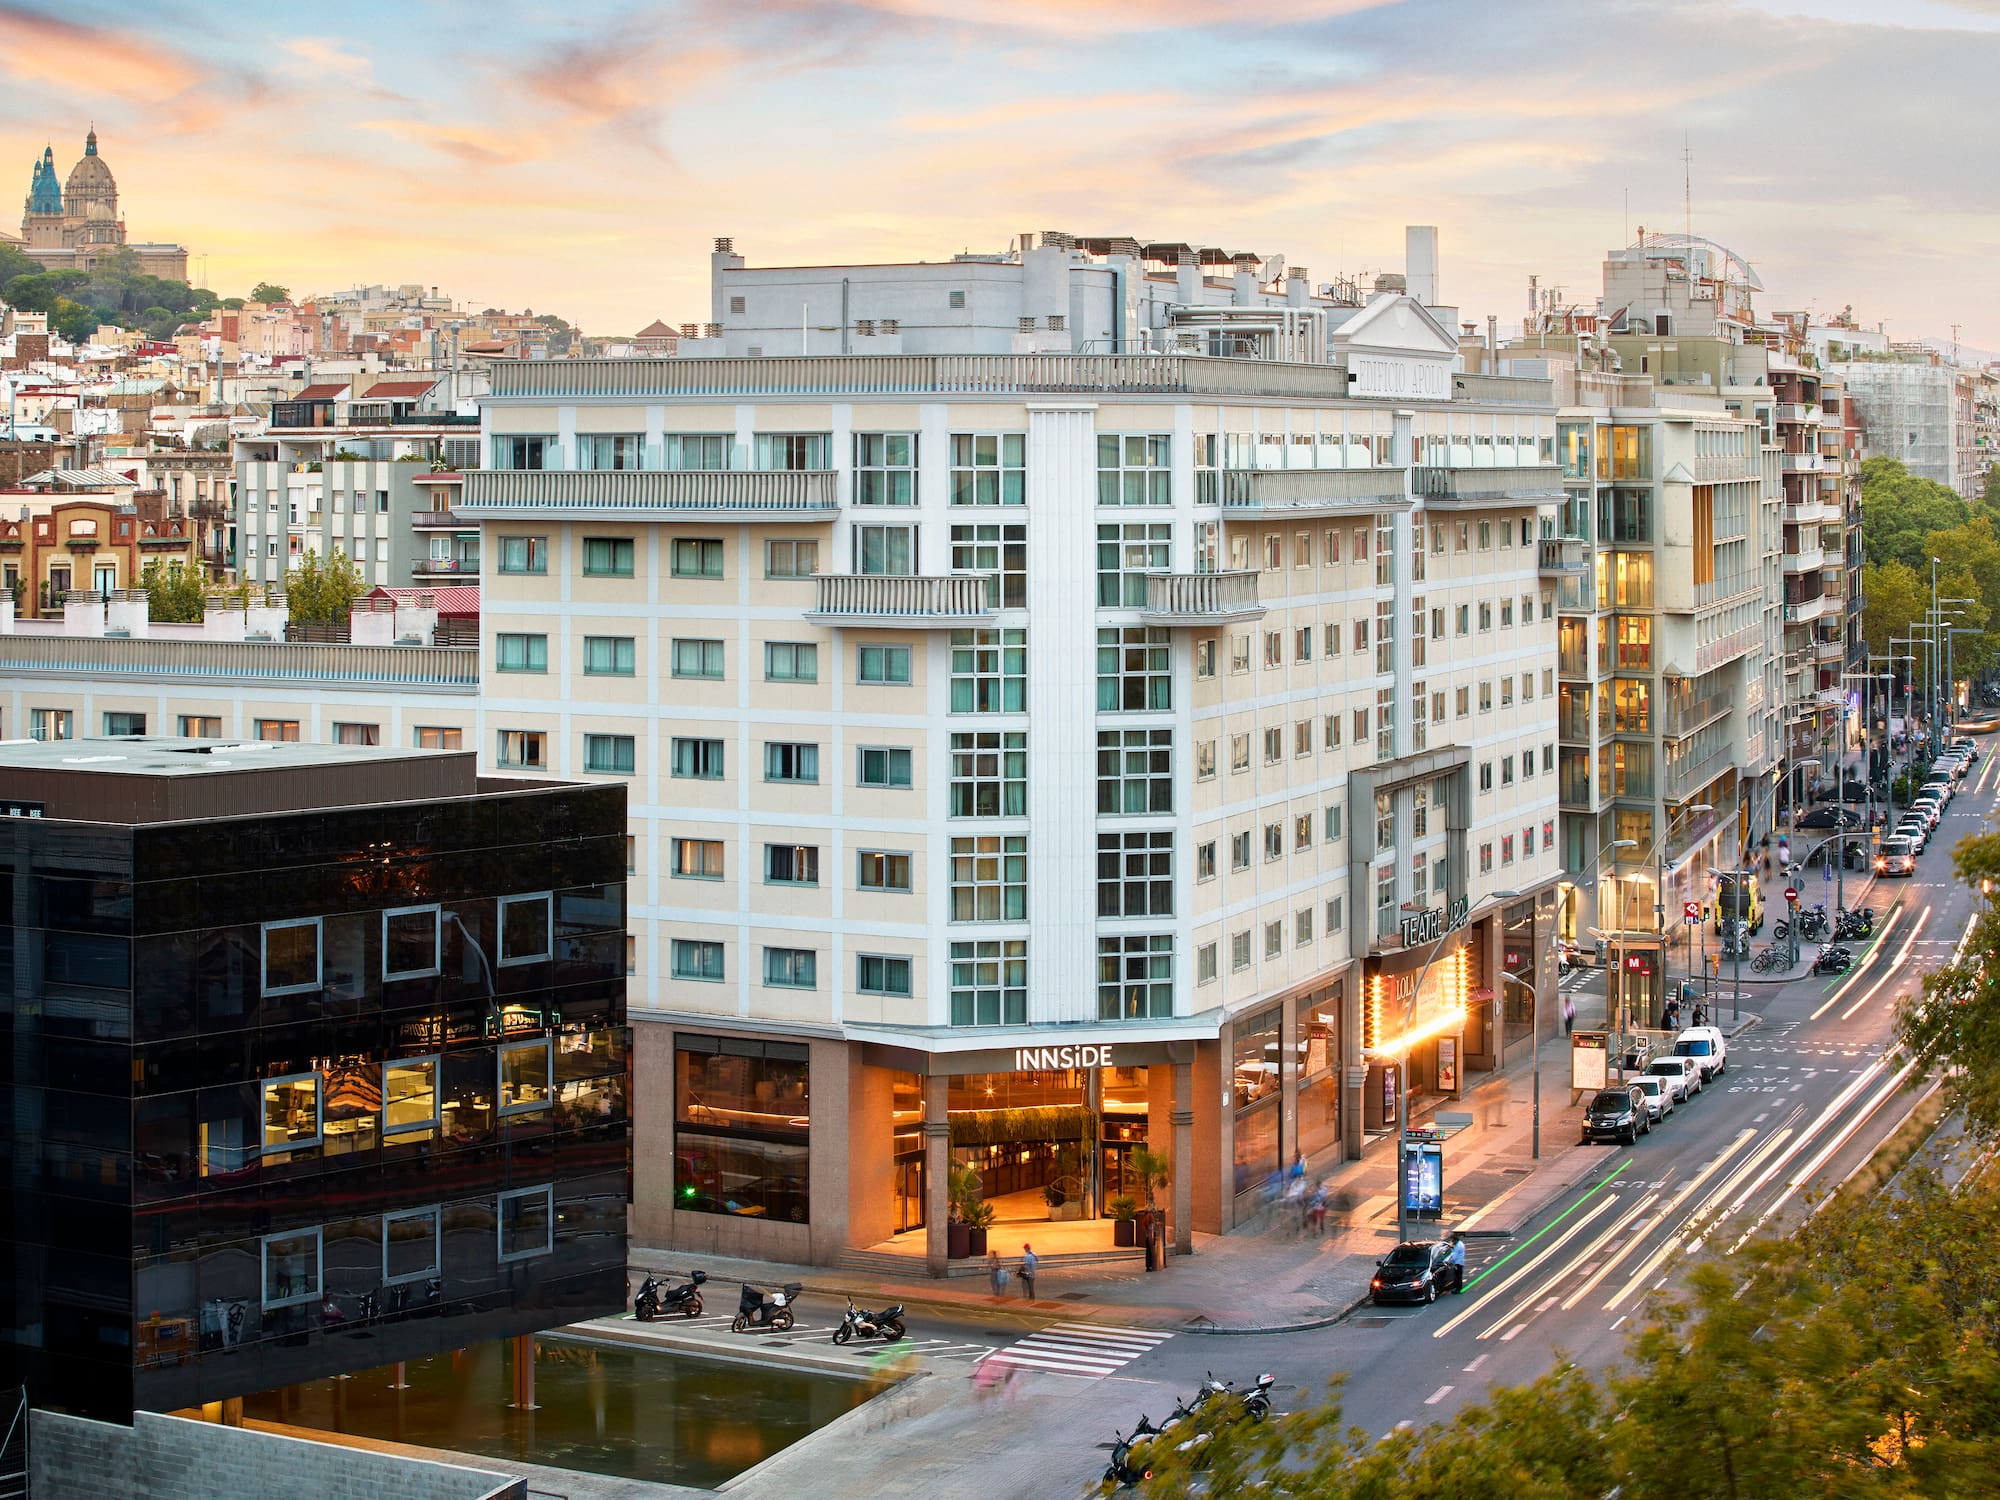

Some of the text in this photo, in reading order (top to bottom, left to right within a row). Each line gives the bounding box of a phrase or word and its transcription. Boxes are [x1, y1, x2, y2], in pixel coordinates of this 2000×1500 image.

[1360, 360, 1443, 394] EDIFICIO APOLO
[1401, 907, 1442, 948] TEATRE
[1507, 954, 1518, 963] M
[1629, 958, 1640, 968] M
[1396, 974, 1415, 1001] LOLA
